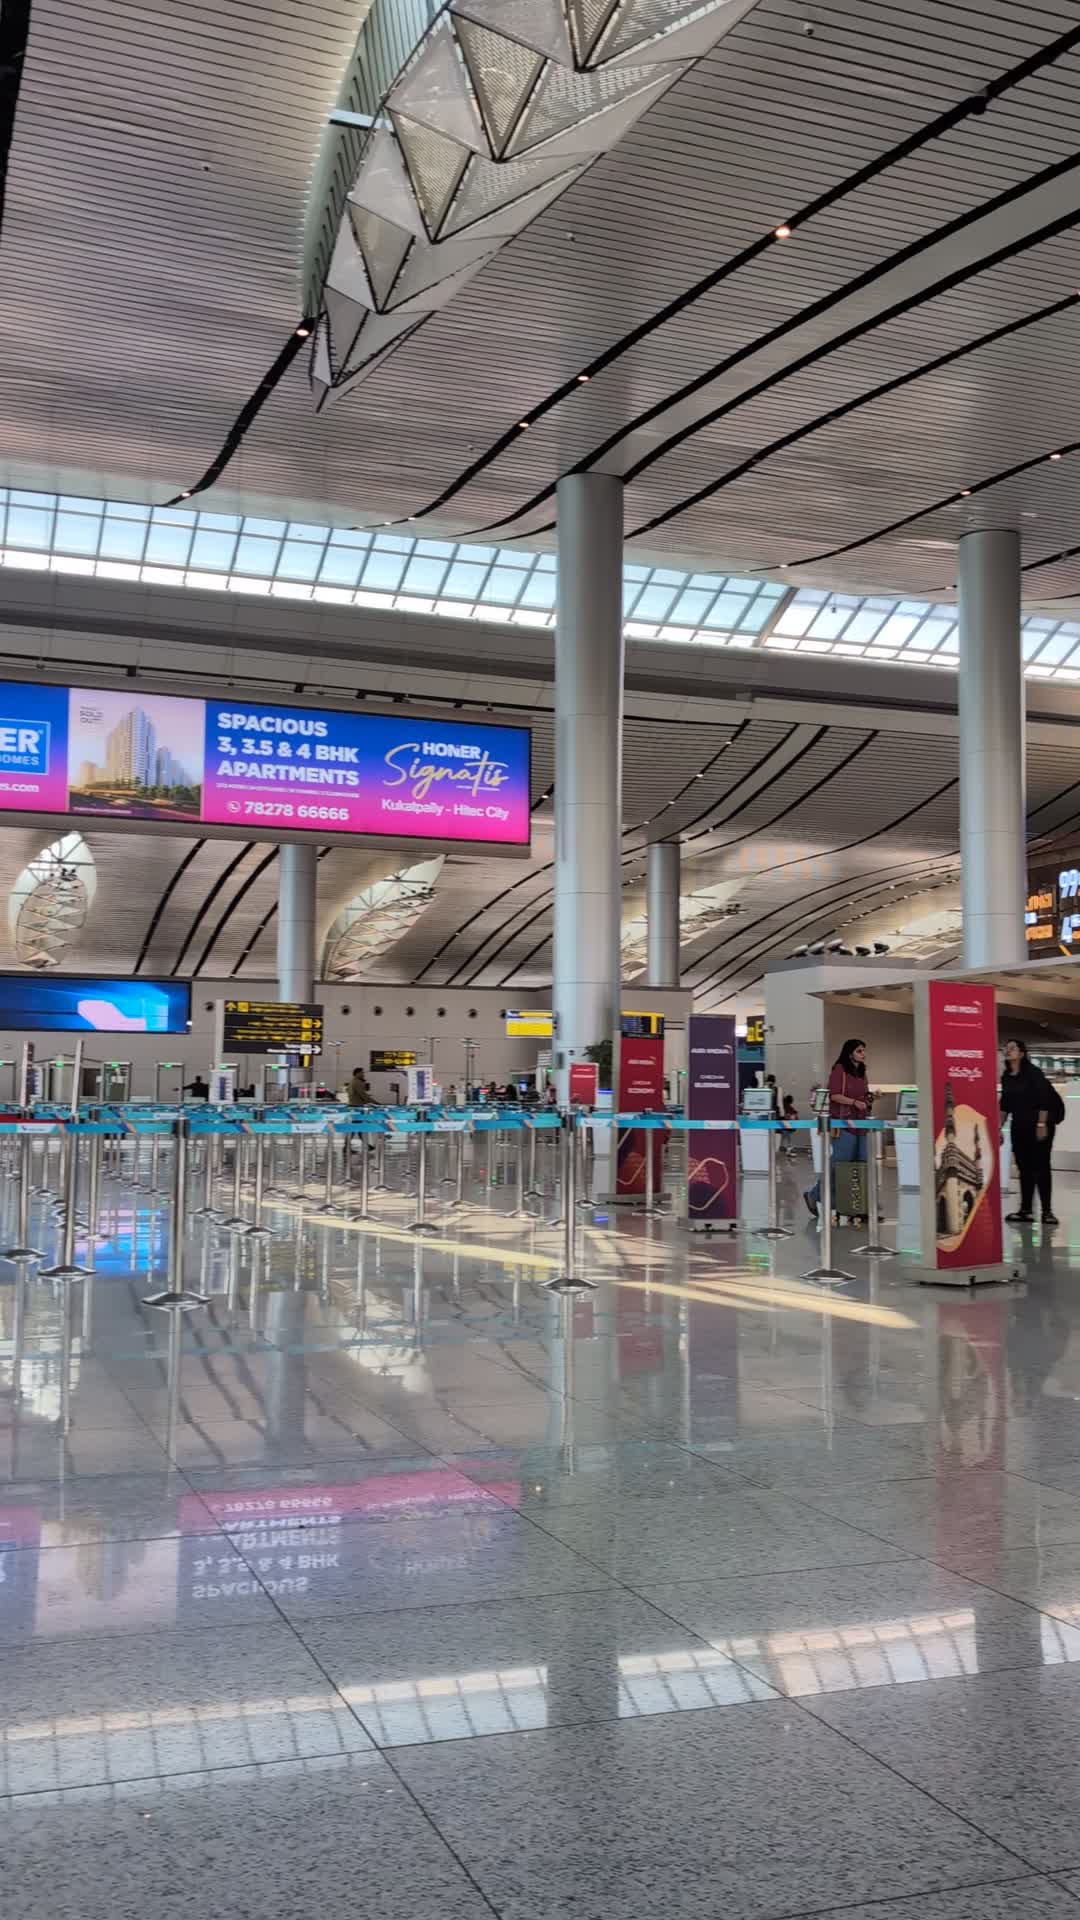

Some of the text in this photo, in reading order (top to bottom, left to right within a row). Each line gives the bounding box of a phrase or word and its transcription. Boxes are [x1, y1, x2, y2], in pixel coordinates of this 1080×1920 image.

[217, 712, 328, 737] SPACIOUS
[217, 736, 360, 763] 3, 3.5 & 4 BHK
[422, 742, 481, 760] HONER
[216, 759, 360, 786] APARTMENTS
[383, 742, 510, 800] Signatis
[244, 801, 349, 820] 78278 66666
[382, 799, 444, 816] Kukatpally
[485, 806, 509, 821] City
